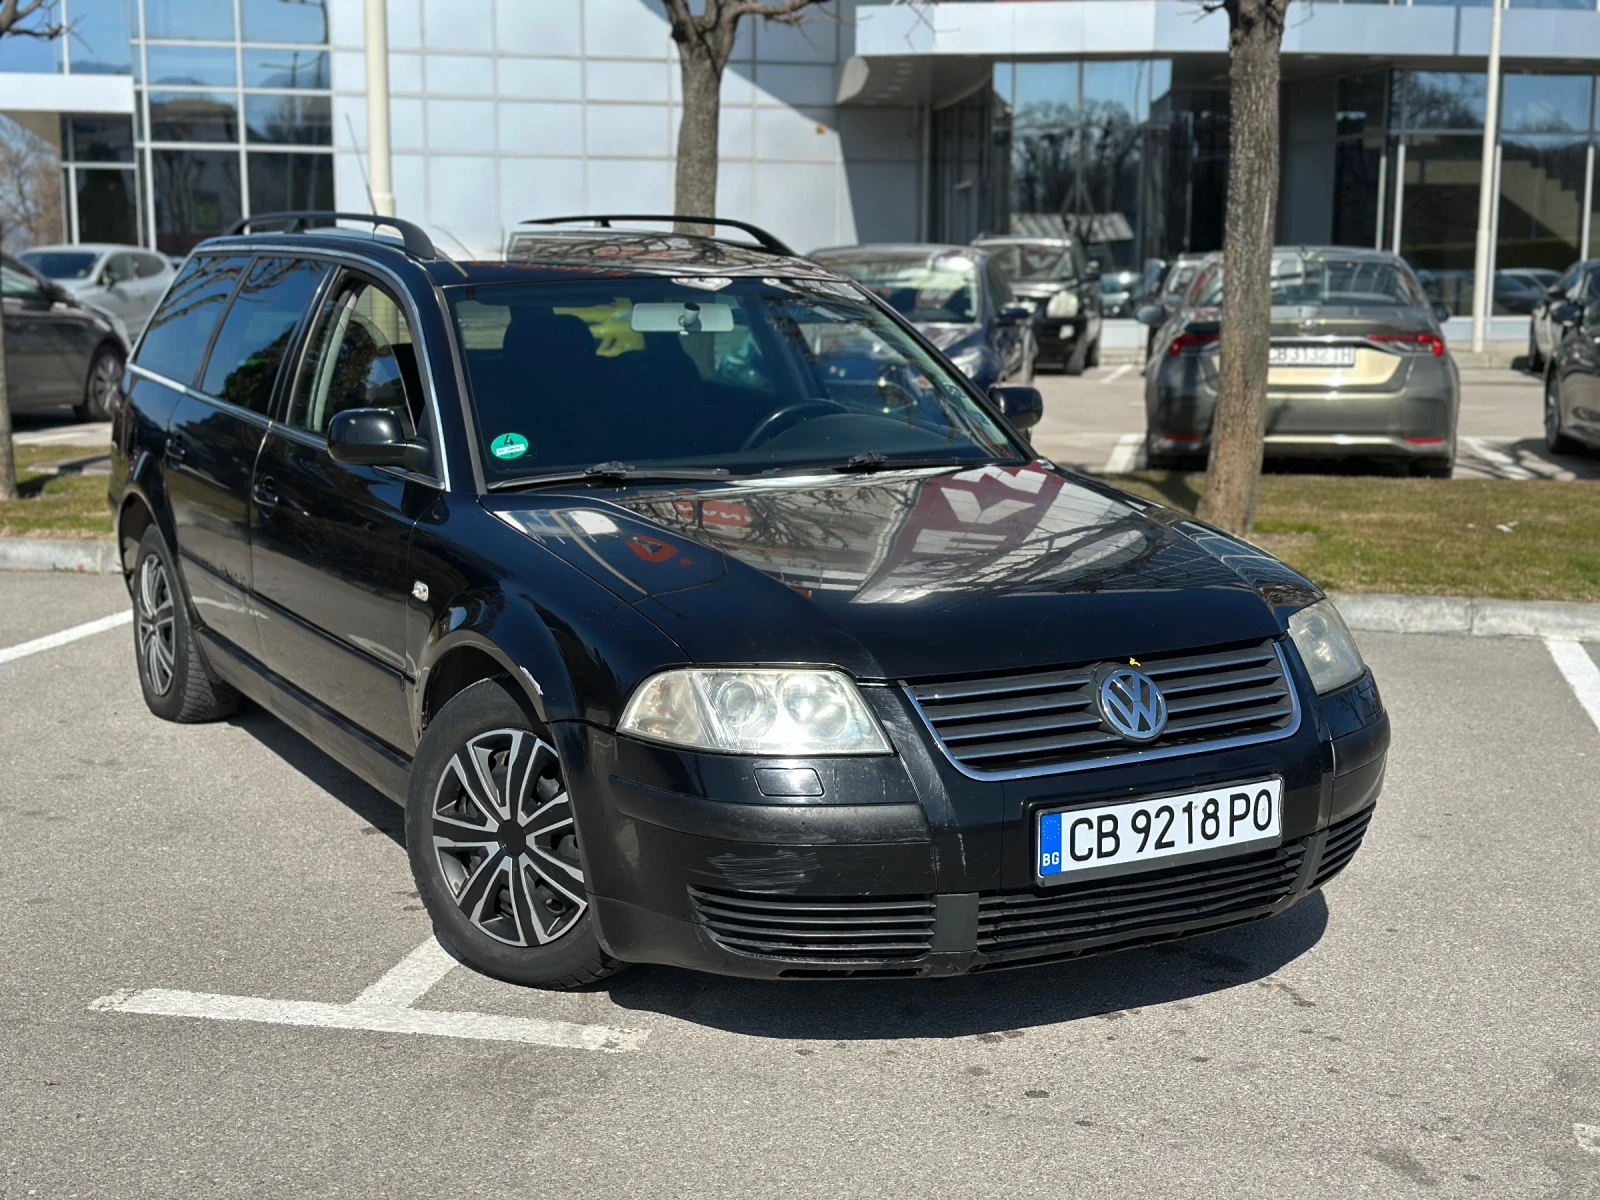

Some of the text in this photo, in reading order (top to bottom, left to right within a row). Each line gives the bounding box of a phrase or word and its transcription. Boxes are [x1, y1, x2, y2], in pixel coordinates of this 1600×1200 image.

[504, 434, 514, 446] 4
[1069, 814, 1121, 862] CB
[1130, 798, 1220, 854] 9218
[1042, 852, 1060, 867] BG
